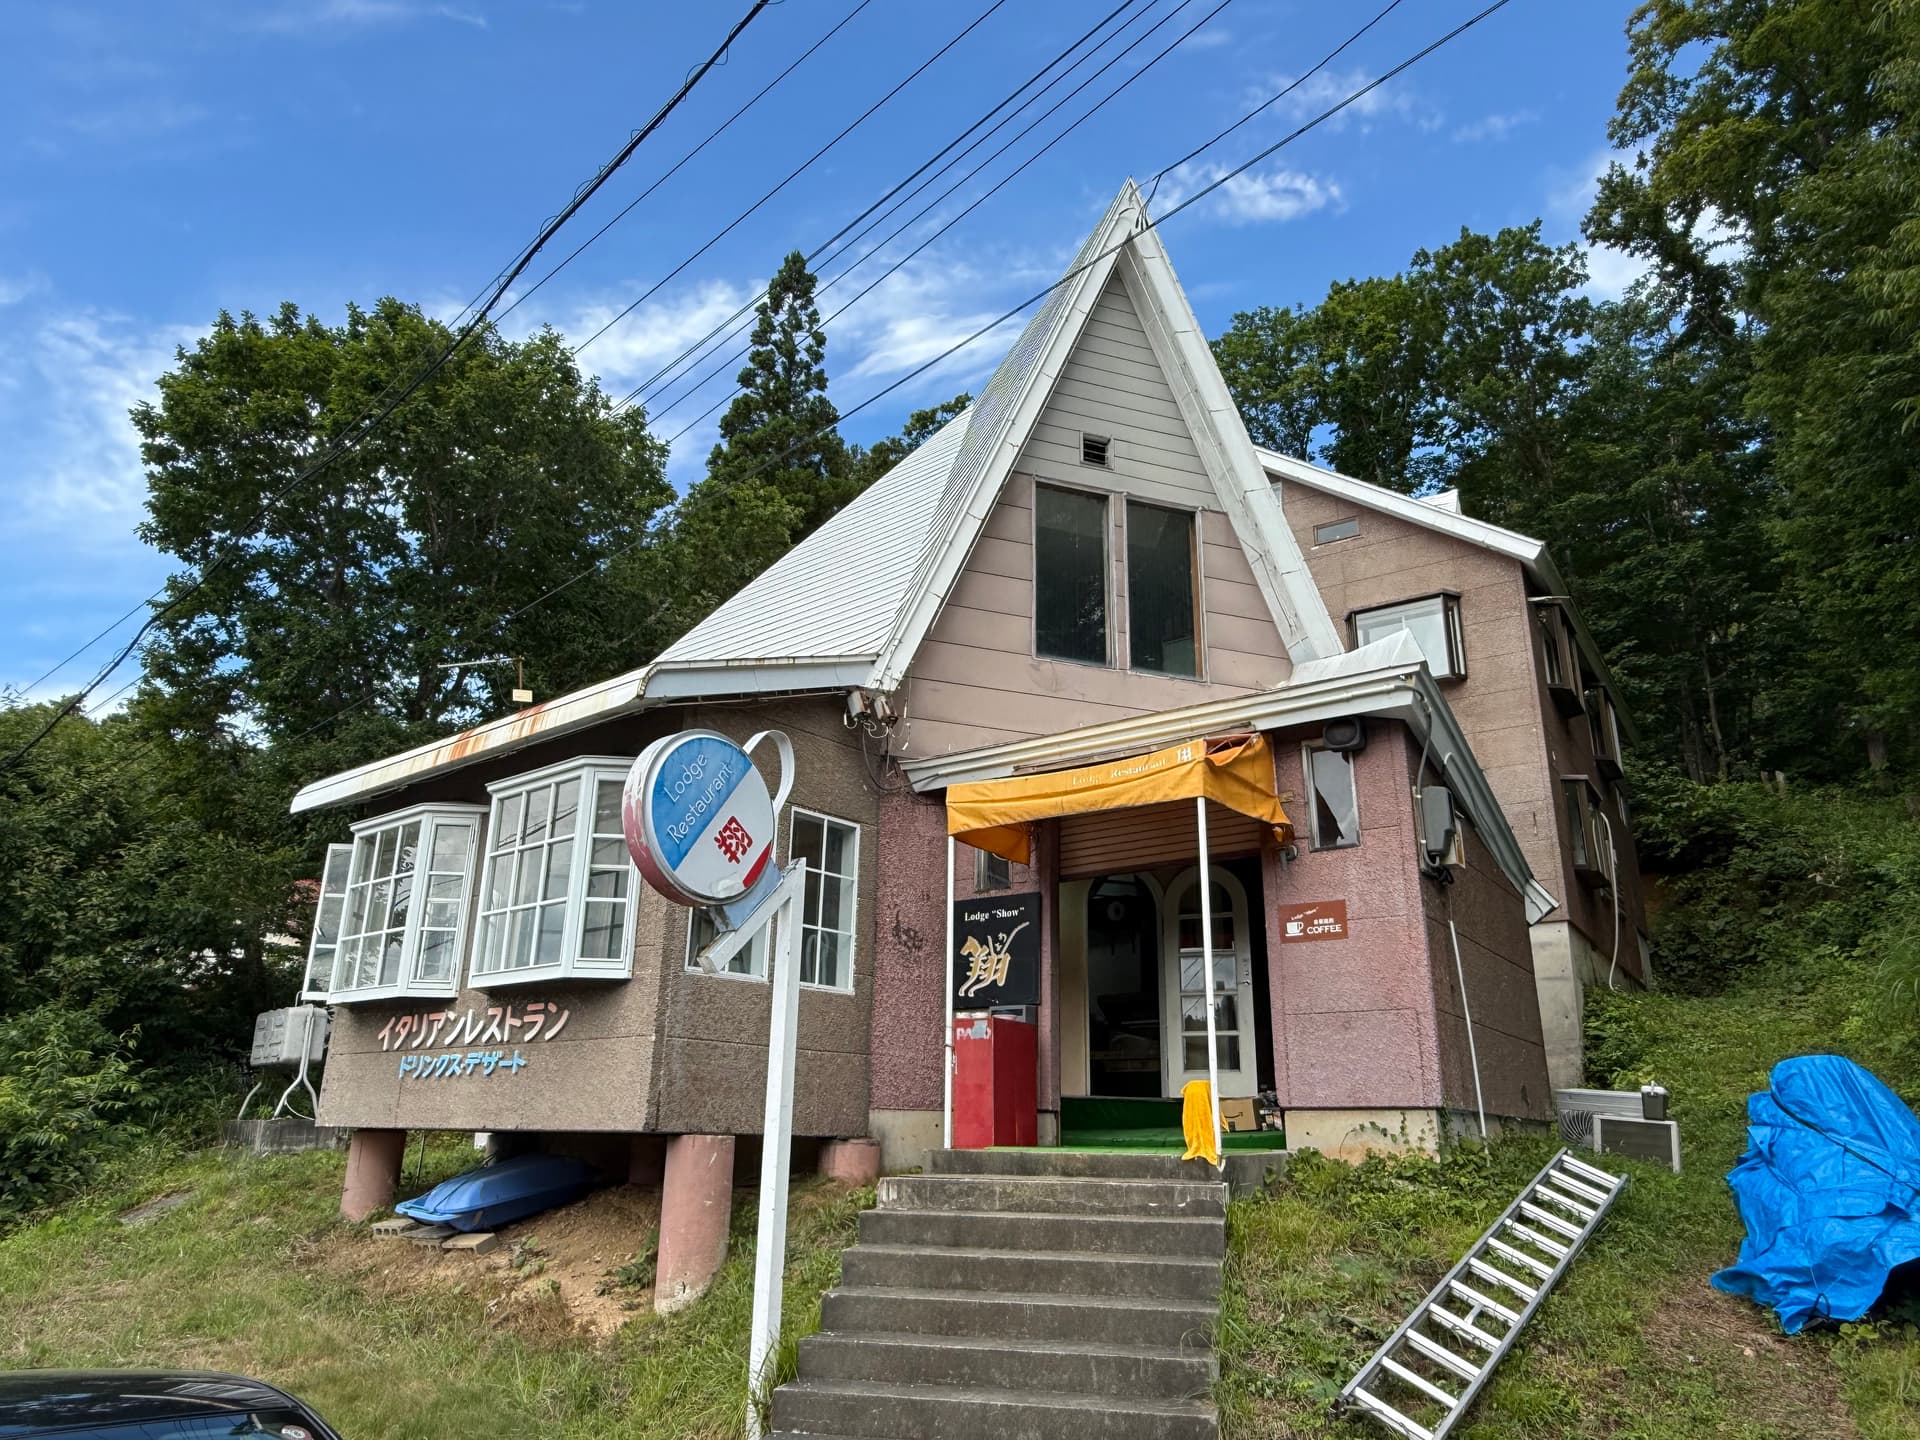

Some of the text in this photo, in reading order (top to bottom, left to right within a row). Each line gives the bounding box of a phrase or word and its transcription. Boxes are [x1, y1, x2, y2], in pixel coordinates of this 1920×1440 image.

[664, 752, 708, 802] Lodge
[666, 761, 735, 844] Restaurant
[964, 911, 990, 922] Lodge
[1306, 924, 1342, 934] COFFEE
[378, 1001, 569, 1051] イタリアンレストラン
